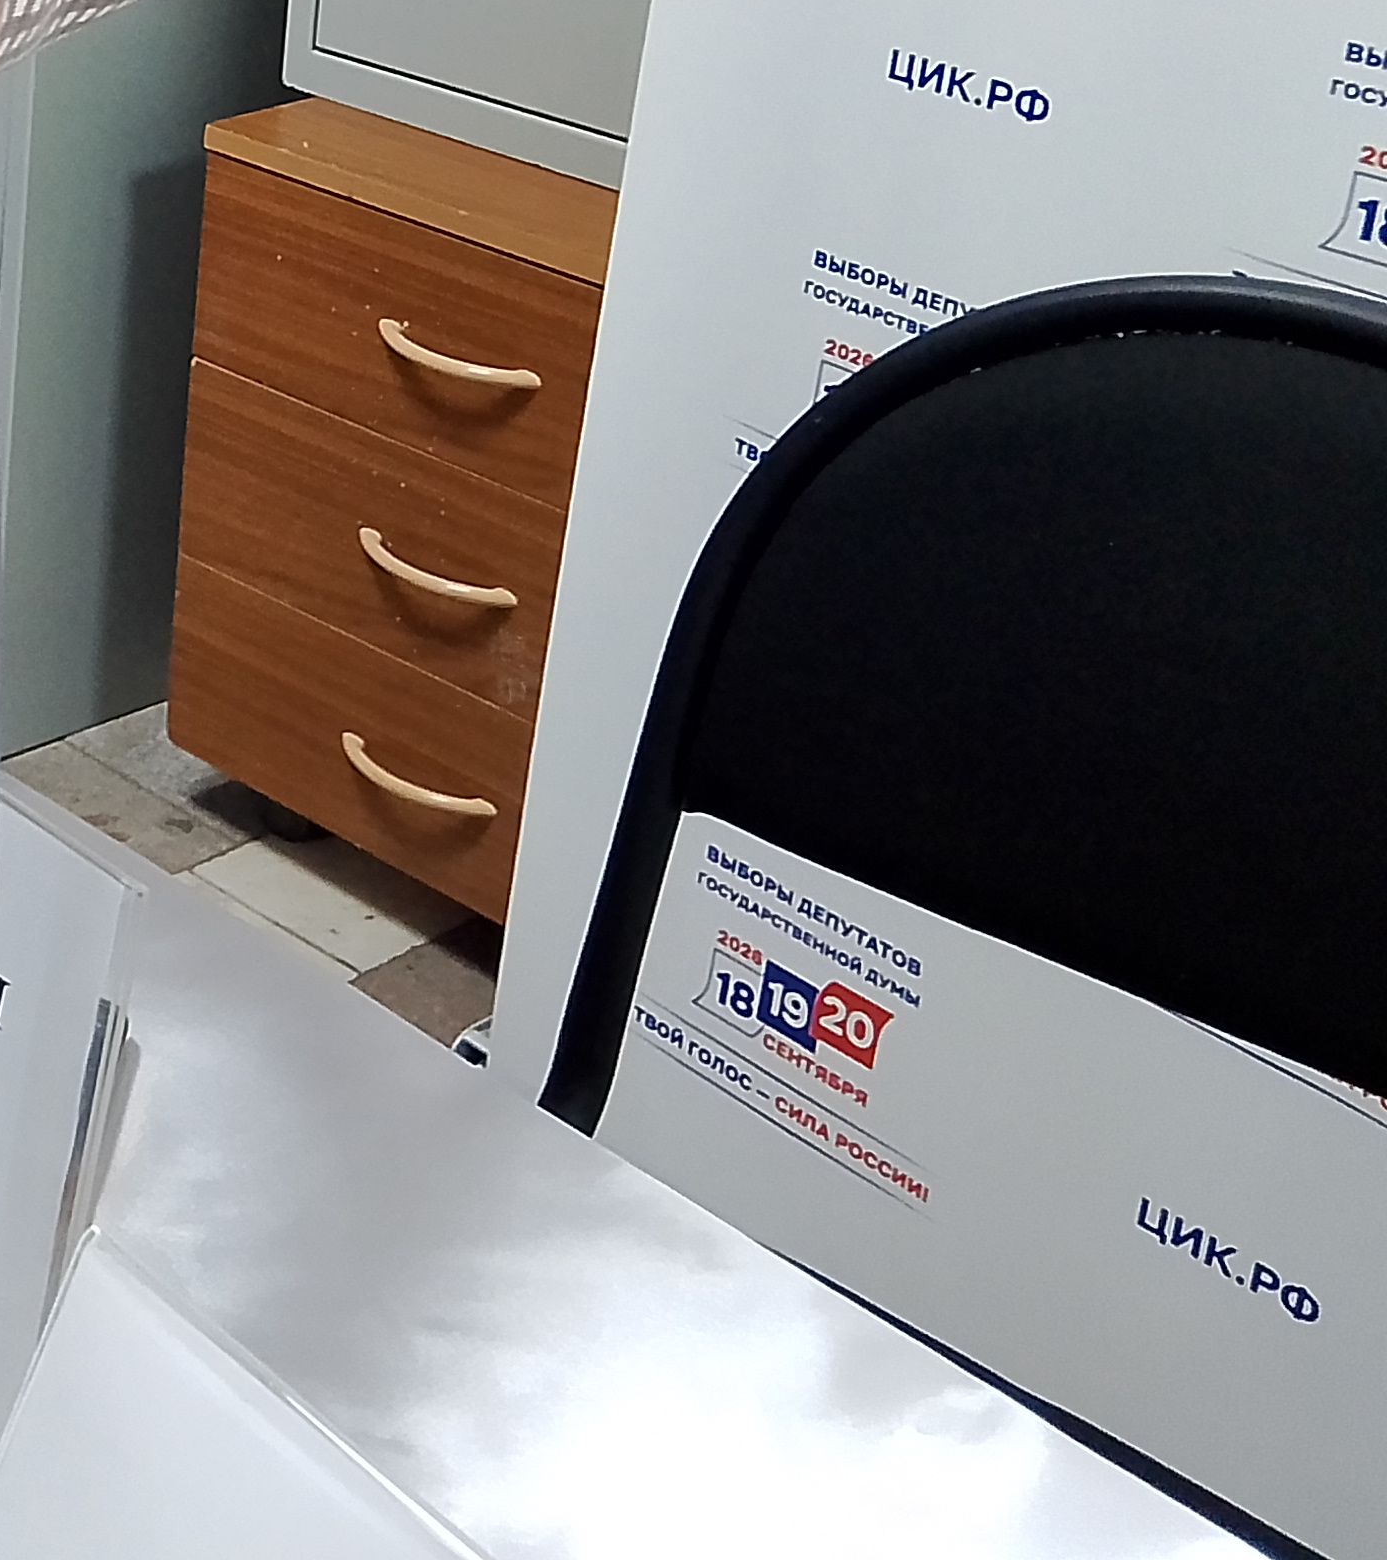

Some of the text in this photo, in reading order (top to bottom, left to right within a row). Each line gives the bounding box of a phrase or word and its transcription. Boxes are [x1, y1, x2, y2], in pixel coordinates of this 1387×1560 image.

[887, 48, 1050, 122] ЦИК.РФ
[813, 250, 908, 298] ВЫБОРЫ
[824, 339, 874, 366] 2026
[735, 438, 767, 461] ТВ
[697, 872, 920, 1008] ГОСУДАРСТВЕННОЙ ДУМЫ
[707, 845, 921, 977] ВЫБОРЫ ДЕПУТАТОВ
[717, 930, 763, 965] 2026
[716, 972, 875, 1049] 18 19 20
[634, 1006, 684, 1049] ТВОЙ
[687, 1041, 752, 1091] ГОЛОС
[775, 1096, 829, 1141] СИЛА
[835, 1134, 929, 1202] РОССИИ!
[763, 1034, 868, 1107] СЕНТЯБРЯ
[1136, 1197, 1320, 1323] ЦИК.РФ
